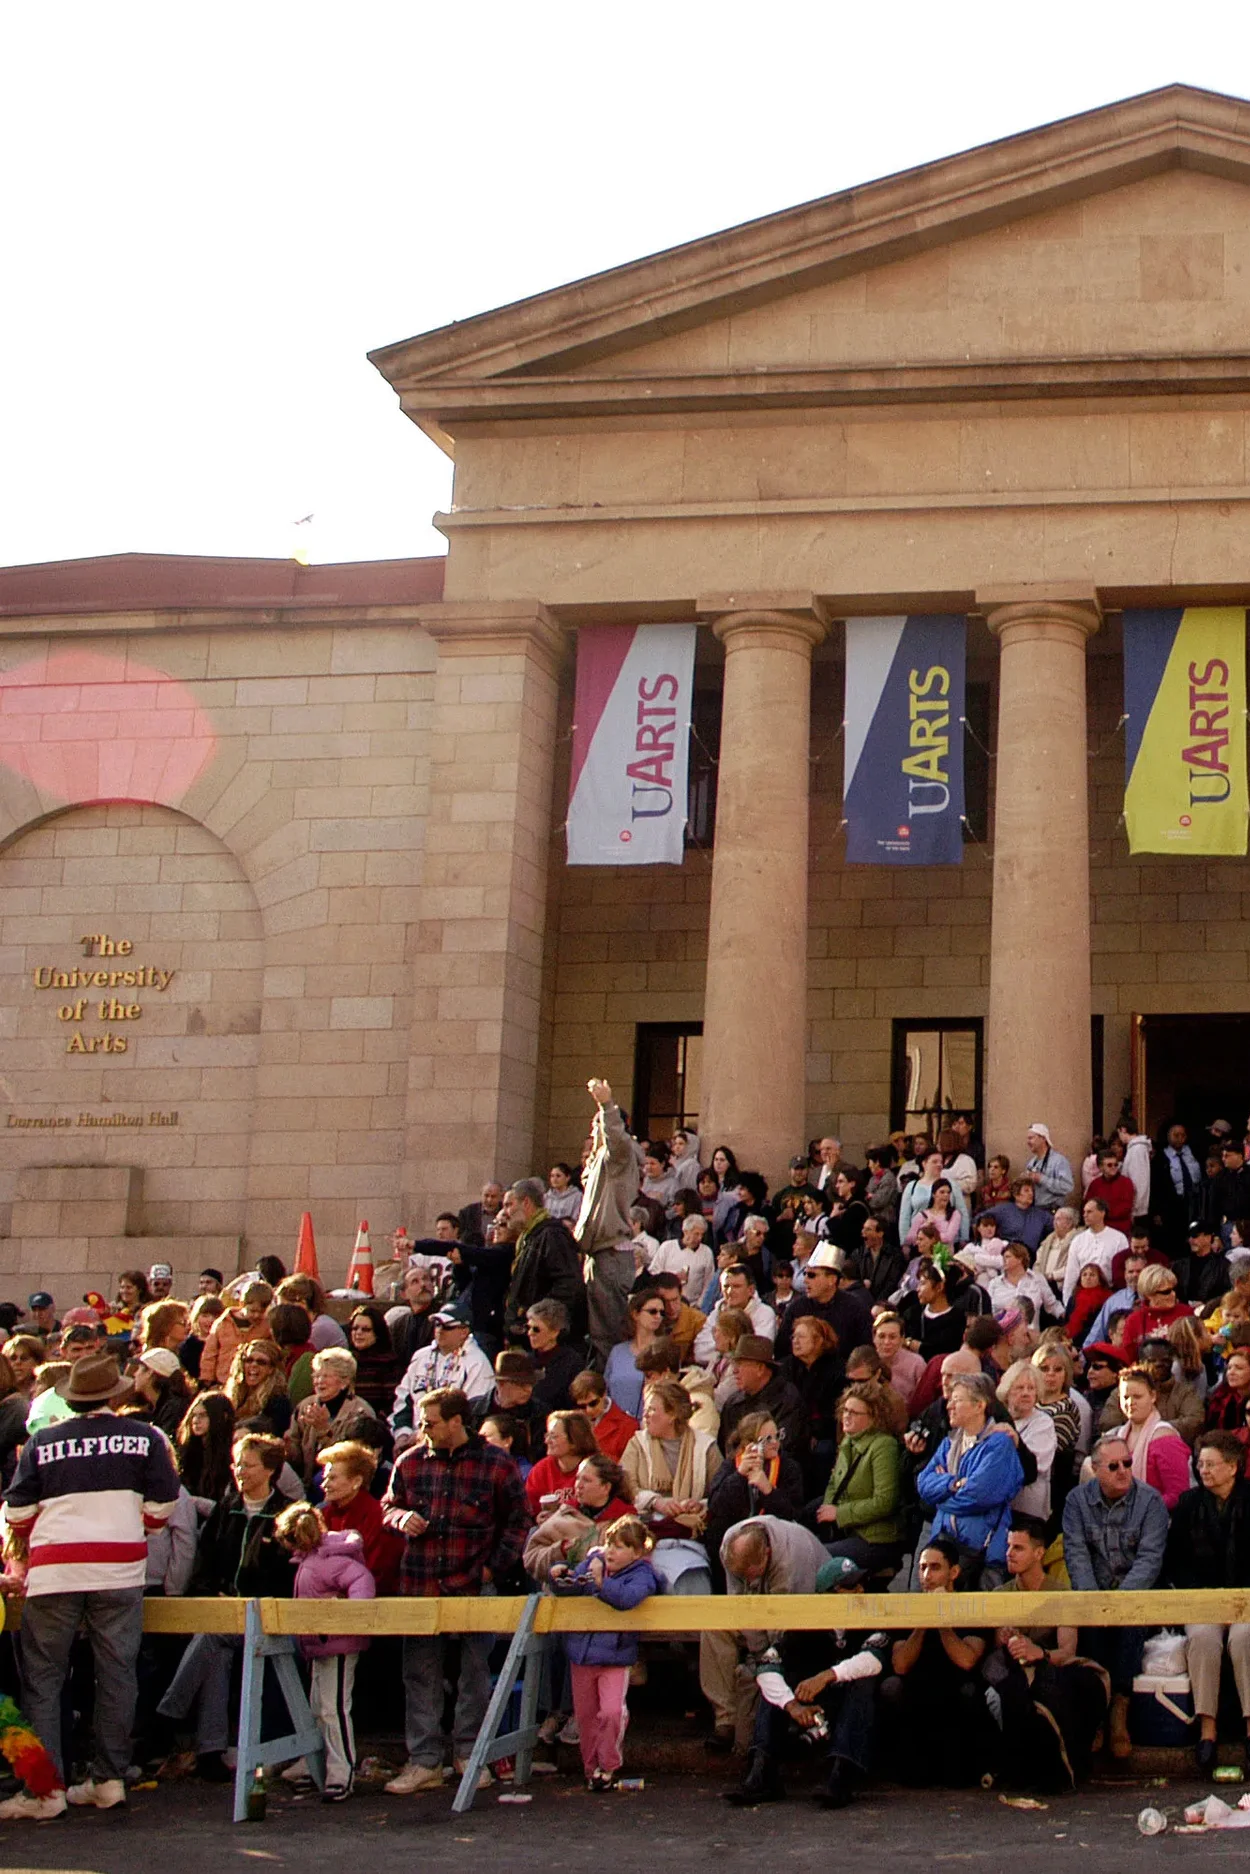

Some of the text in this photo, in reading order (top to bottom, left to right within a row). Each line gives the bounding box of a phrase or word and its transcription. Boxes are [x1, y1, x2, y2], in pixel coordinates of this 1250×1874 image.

[901, 665, 950, 818] UARTS
[1181, 658, 1230, 808] UARTS
[626, 673, 679, 822] UARTS
[80, 934, 133, 958] The
[32, 965, 175, 990] University
[56, 998, 142, 1021] of the
[66, 1031, 128, 1053] Arts
[6, 1111, 179, 1128] Dorrance Hamilton Hall
[37, 1434, 150, 1466] HILFIGER
